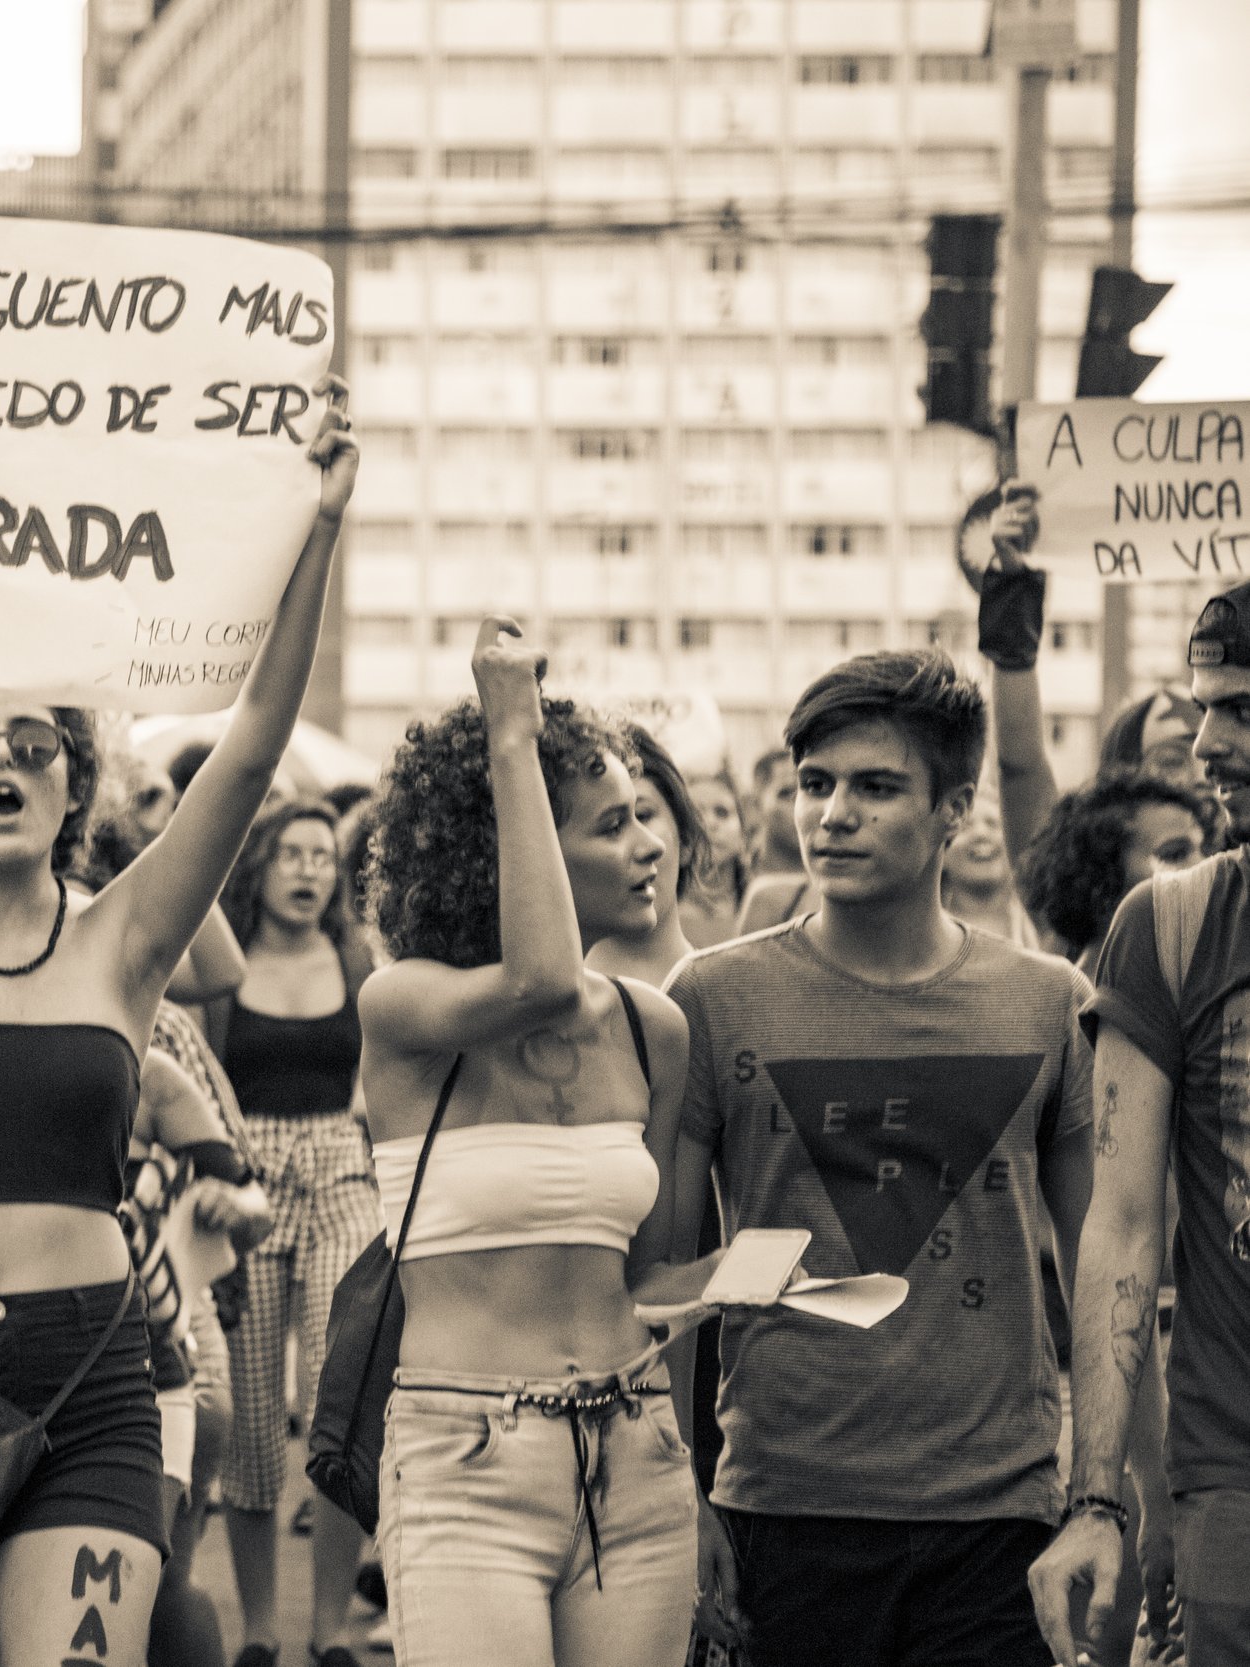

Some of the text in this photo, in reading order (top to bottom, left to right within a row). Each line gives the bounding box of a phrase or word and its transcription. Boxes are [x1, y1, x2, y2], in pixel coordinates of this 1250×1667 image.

[218, 281, 329, 346] MAIS
[106, 384, 172, 433] DE
[194, 381, 312, 444] SER
[1046, 409, 1245, 468] A CULPA
[1114, 479, 1242, 523] NUNCA
[1093, 528, 1250, 576] DA VÍT
[134, 616, 272, 648] MEU CORP
[127, 659, 195, 689] MINHAS
